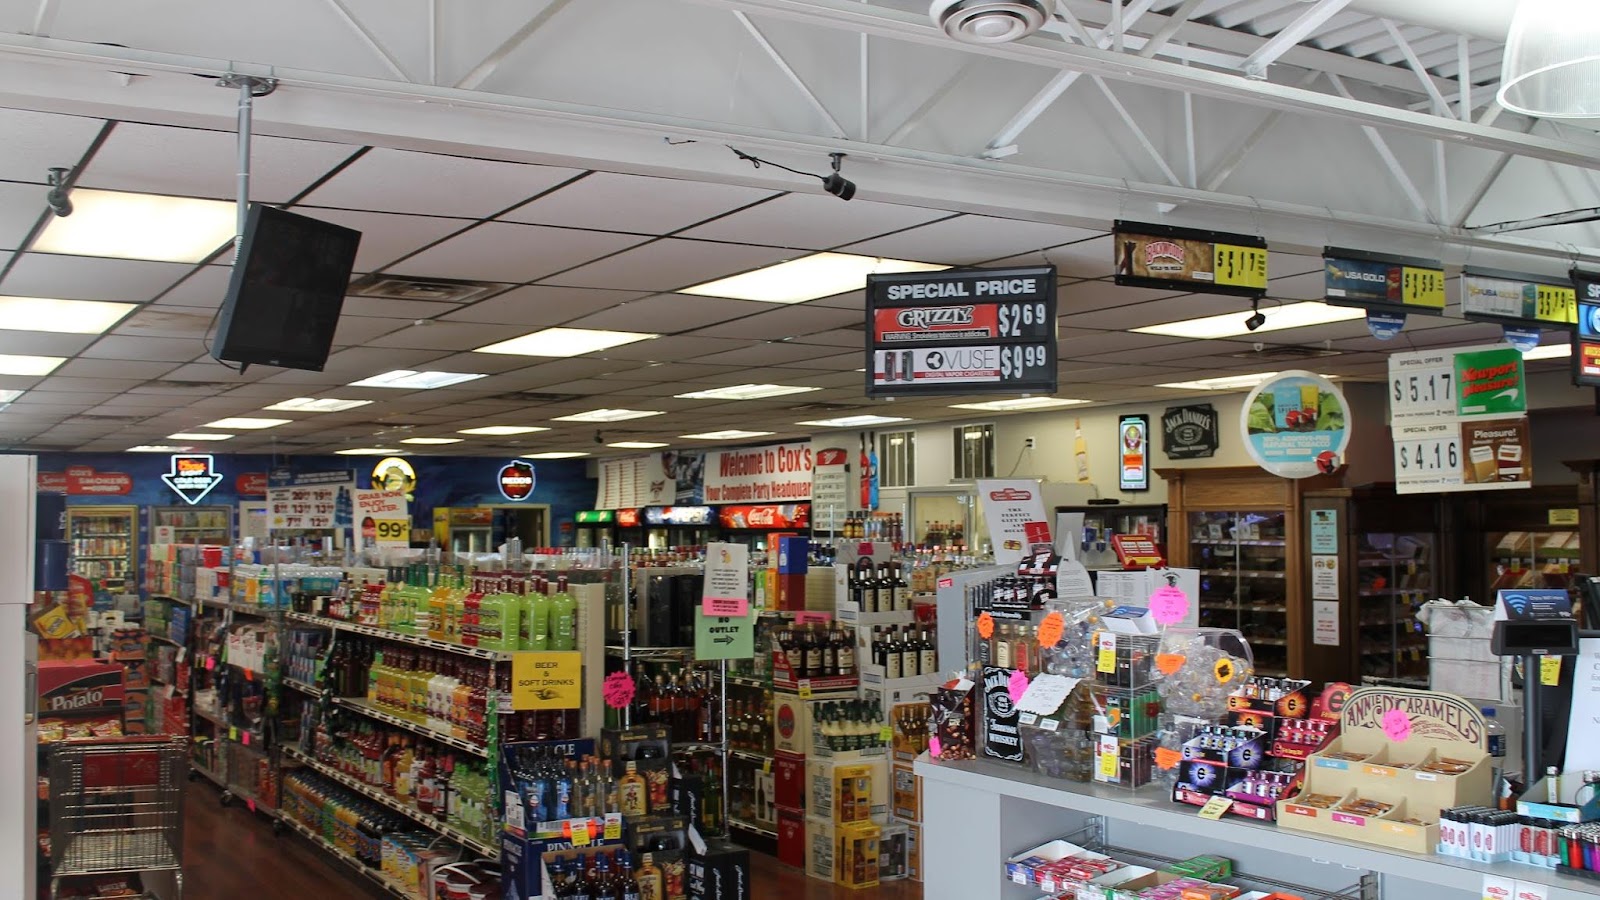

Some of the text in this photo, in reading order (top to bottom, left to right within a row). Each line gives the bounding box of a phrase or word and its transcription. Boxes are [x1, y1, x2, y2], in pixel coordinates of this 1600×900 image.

[1344, 272, 1386, 283] USA GOLD
[887, 279, 1037, 300] SPECIAL PRICE
[896, 305, 976, 330] GRIZZLY
[943, 349, 995, 370] VUSE
[1399, 356, 1443, 367] SPECIAL OFFER
[1461, 361, 1518, 383] Newport
[1394, 373, 1450, 402] $5.17
[1165, 408, 1212, 434] JACK DANIEL'S
[1403, 424, 1447, 433] SPECIAL OFFER
[1473, 428, 1516, 439] Pleasure!
[720, 444, 812, 477] Welcome to Cox's
[1400, 442, 1457, 470] $4.16
[358, 492, 381, 500] GRAB
[706, 485, 721, 501] Your
[722, 483, 752, 502] Complete
[754, 482, 770, 501] Party
[708, 625, 739, 634] OUTLET
[535, 661, 558, 669] BEER
[518, 679, 575, 688] SOFT DRINKS
[52, 689, 103, 711] Potato
[1347, 694, 1381, 727] ANNIE
[1394, 698, 1480, 744] CARAMELS
[988, 732, 1019, 747] WHISKEY
